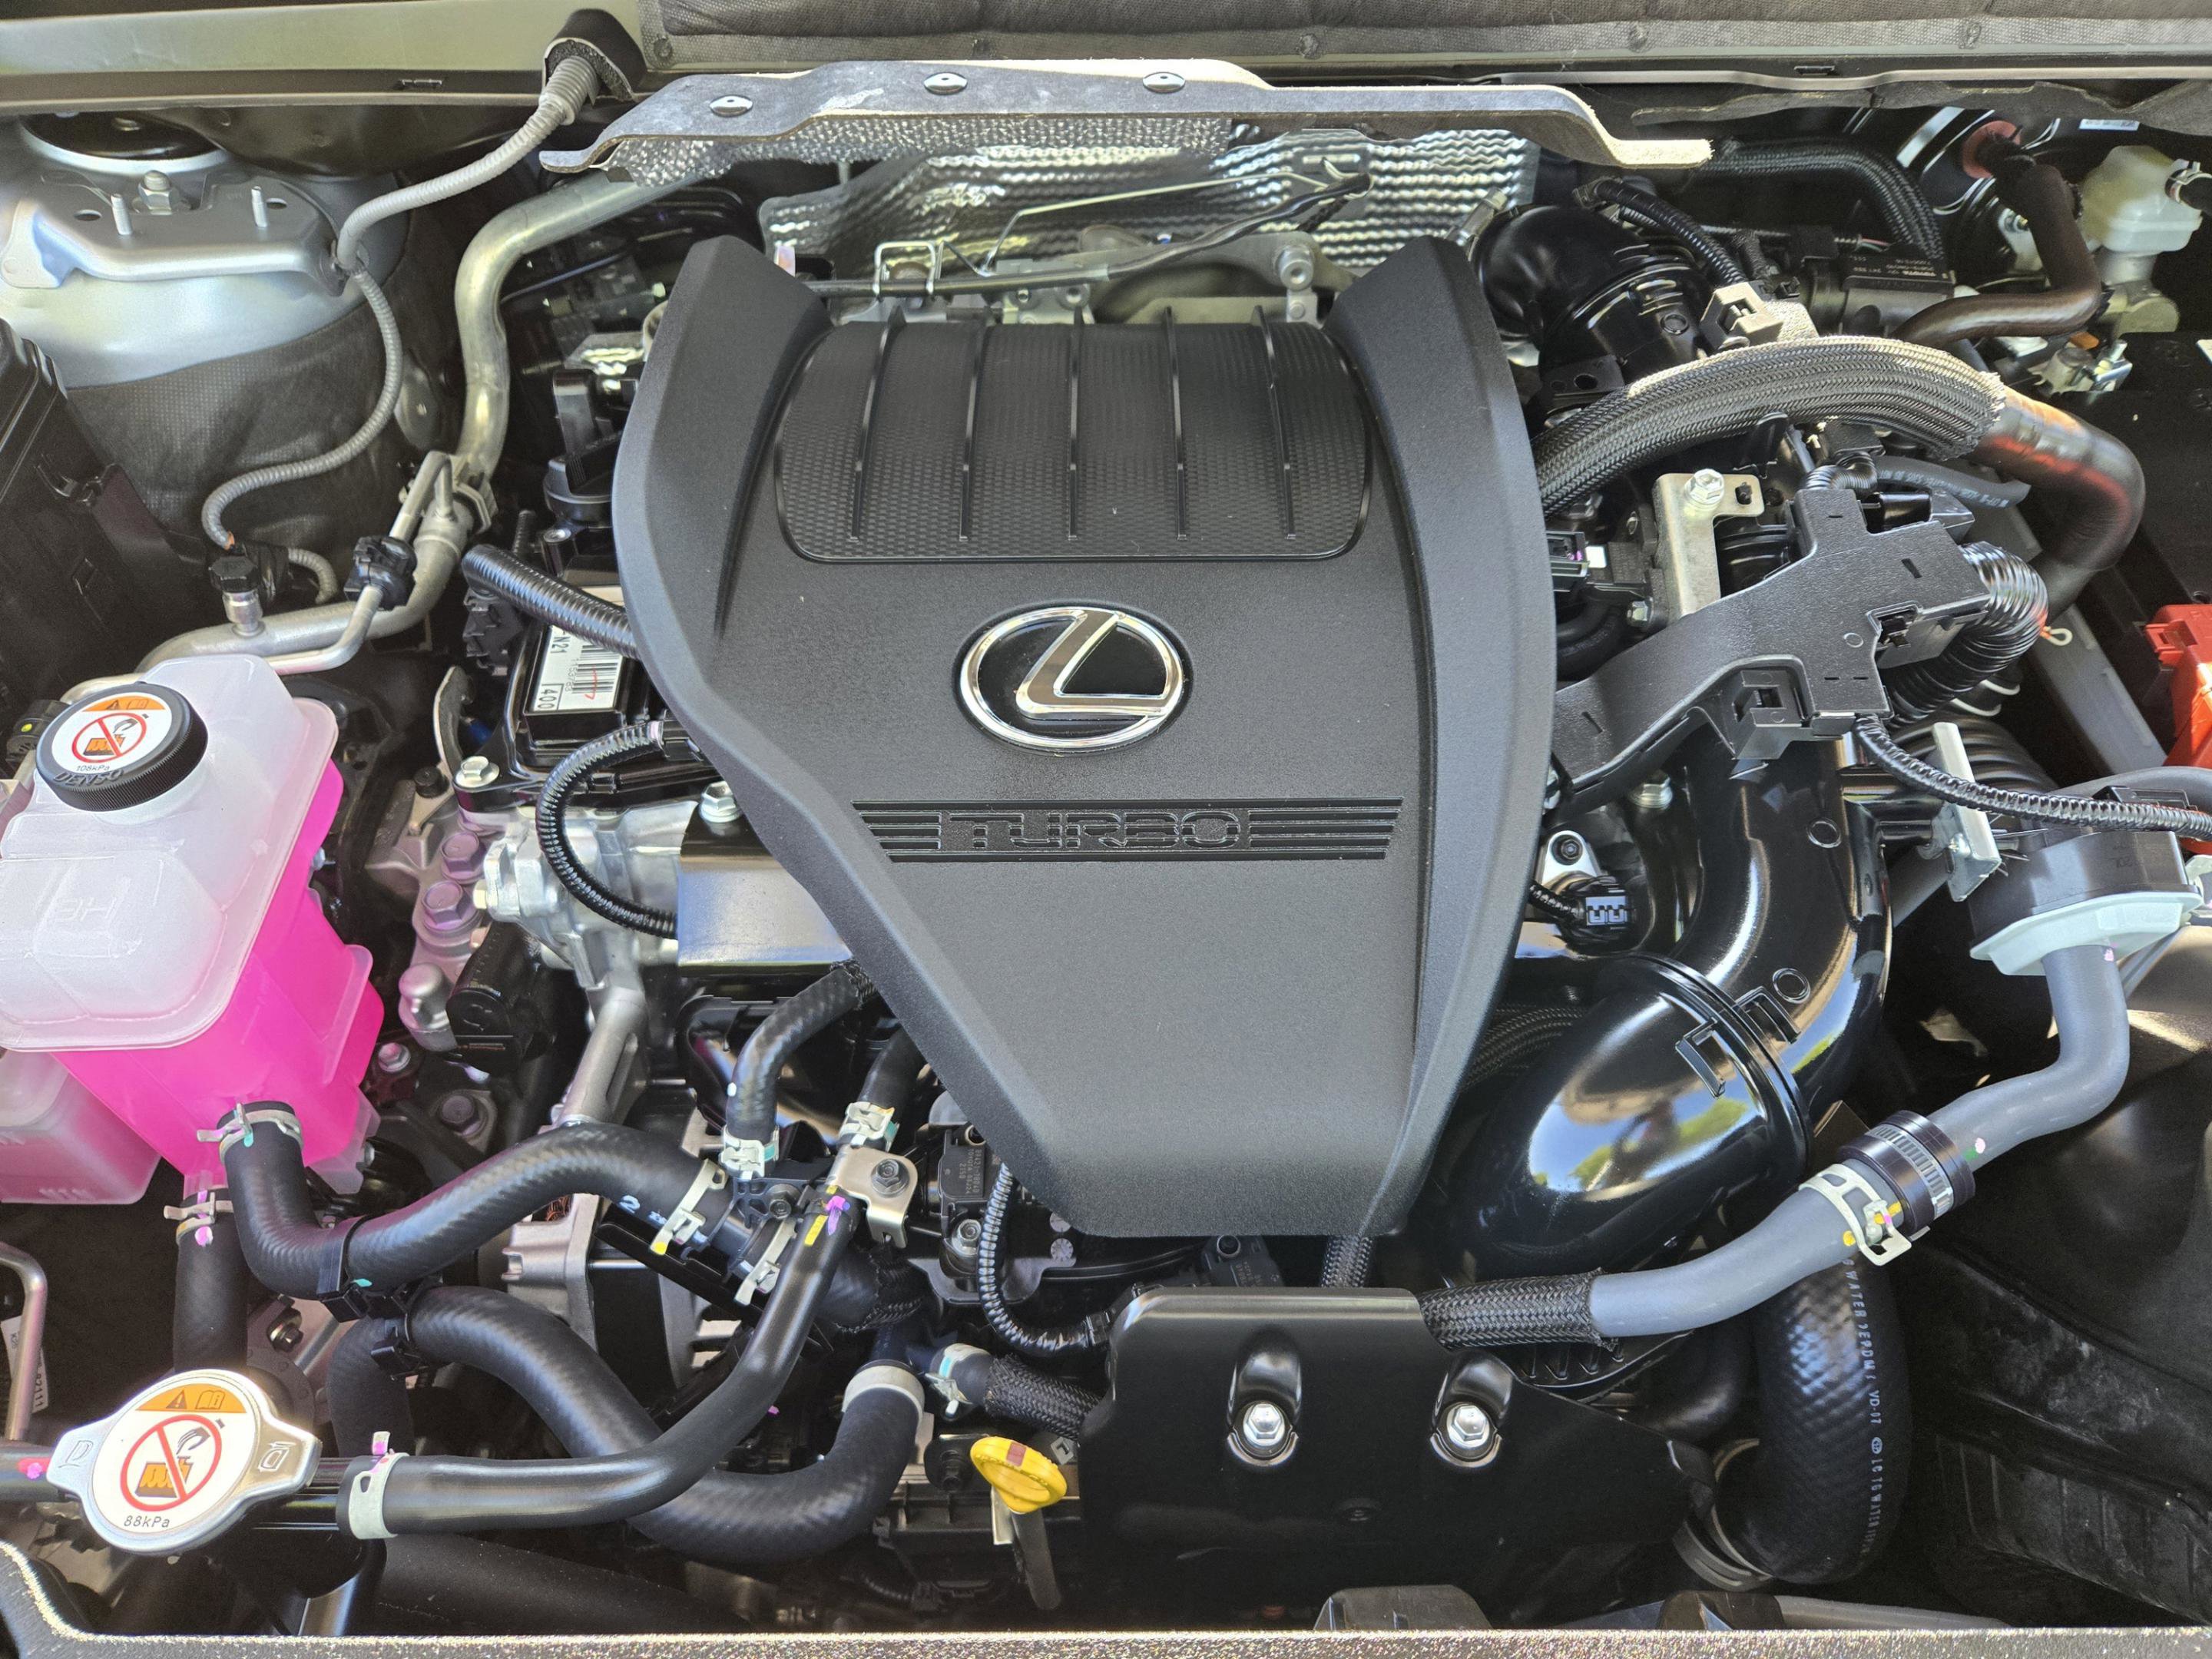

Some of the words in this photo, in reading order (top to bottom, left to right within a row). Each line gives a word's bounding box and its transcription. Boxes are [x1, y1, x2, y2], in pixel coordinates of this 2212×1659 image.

[537, 688, 559, 709] 400
[53, 768, 124, 786] DENSO
[947, 811, 1240, 849] TURBO
[1845, 1270, 1868, 1317] WATER
[123, 1515, 171, 1528] 88kPa
